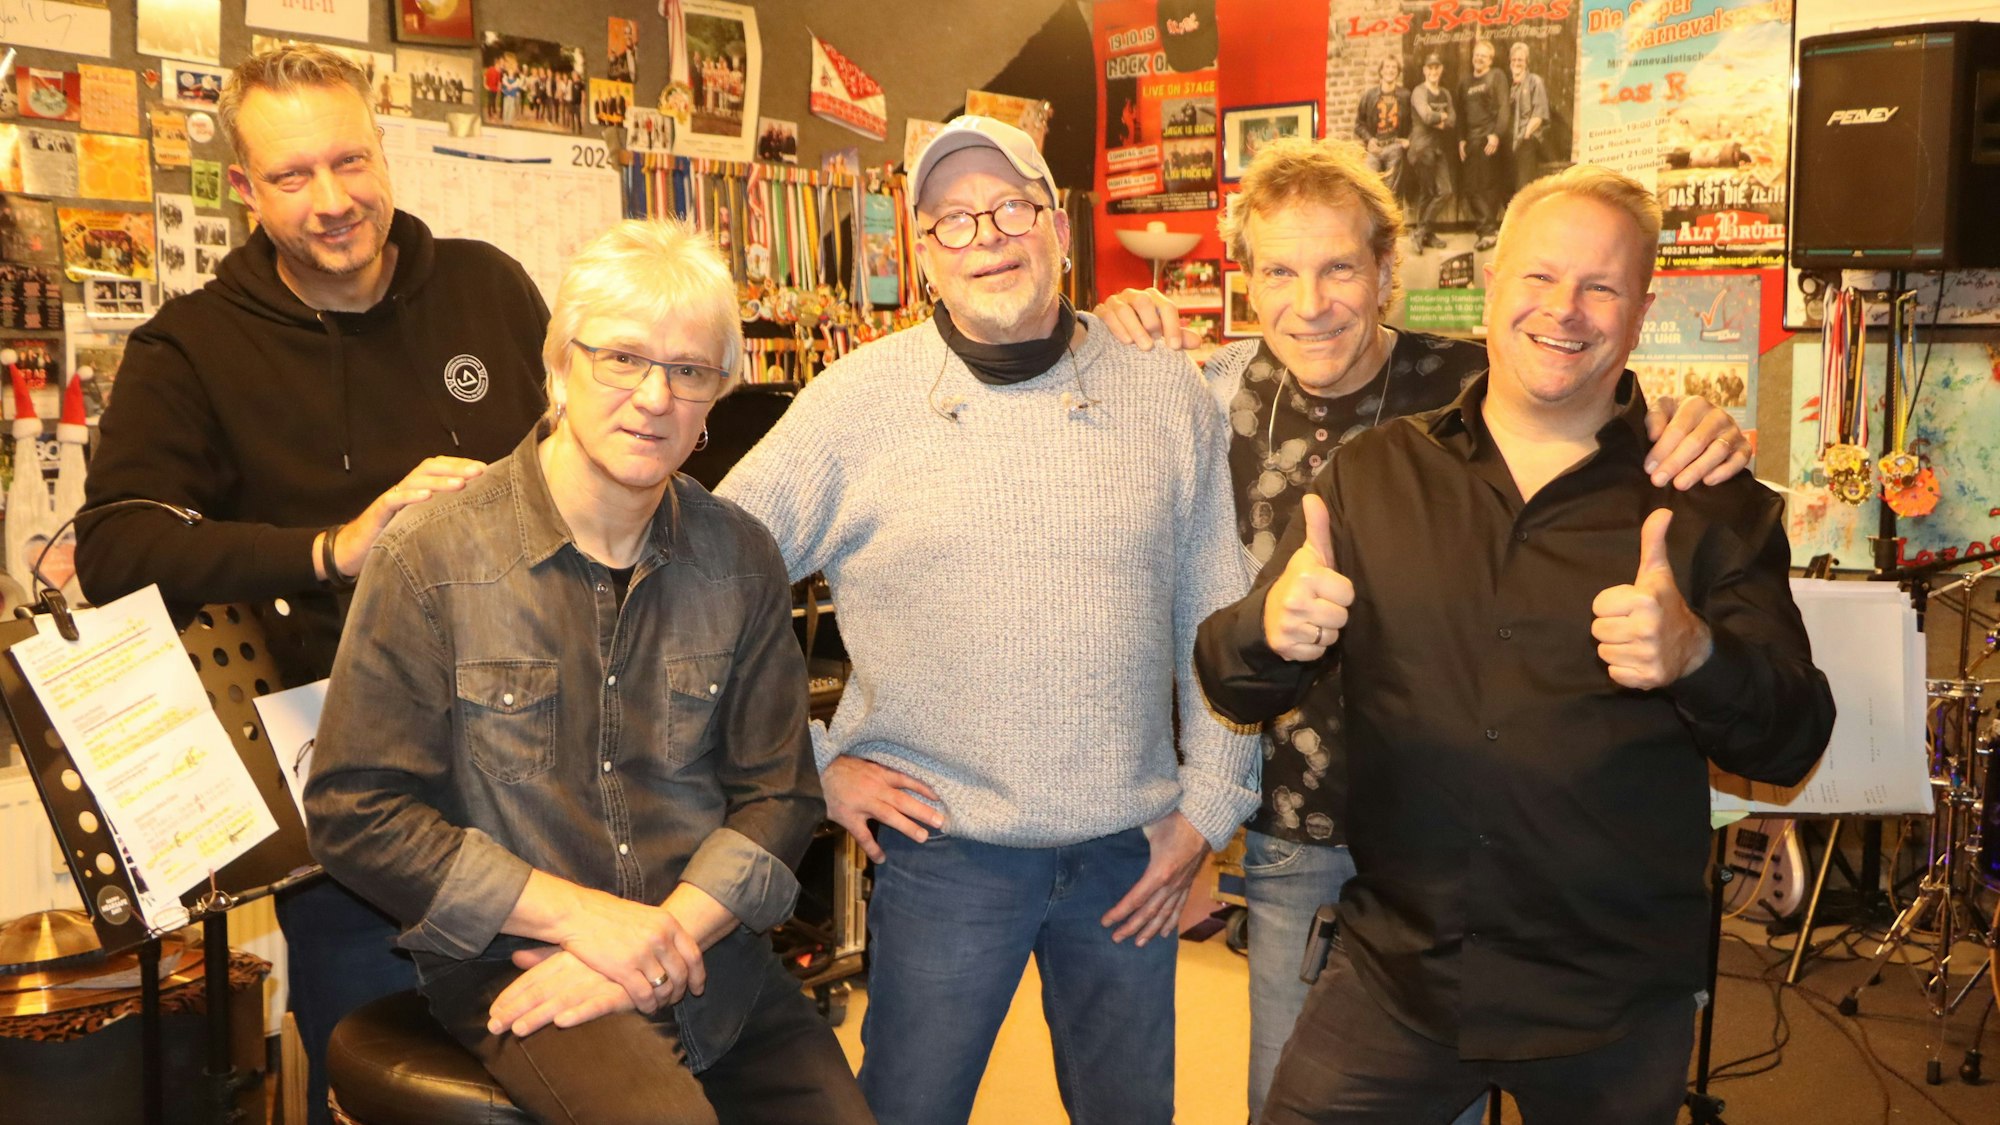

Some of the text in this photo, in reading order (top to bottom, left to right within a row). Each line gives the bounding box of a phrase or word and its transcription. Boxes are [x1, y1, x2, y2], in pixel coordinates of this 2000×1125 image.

[1588, 0, 1692, 34] Die Sper
[1109, 27, 1156, 49] 19.10.19
[1107, 55, 1149, 77] ROCK
[1143, 80, 1216, 96] LIVE ON STAGE
[1826, 106, 1899, 126] PEAVEY
[572, 144, 611, 169] 202
[1668, 187, 1696, 207] DAS
[1689, 245, 1714, 254] Brühl
[1672, 254, 1785, 267] www.brauhausgarten.d
[1654, 333, 1682, 344] UHR
